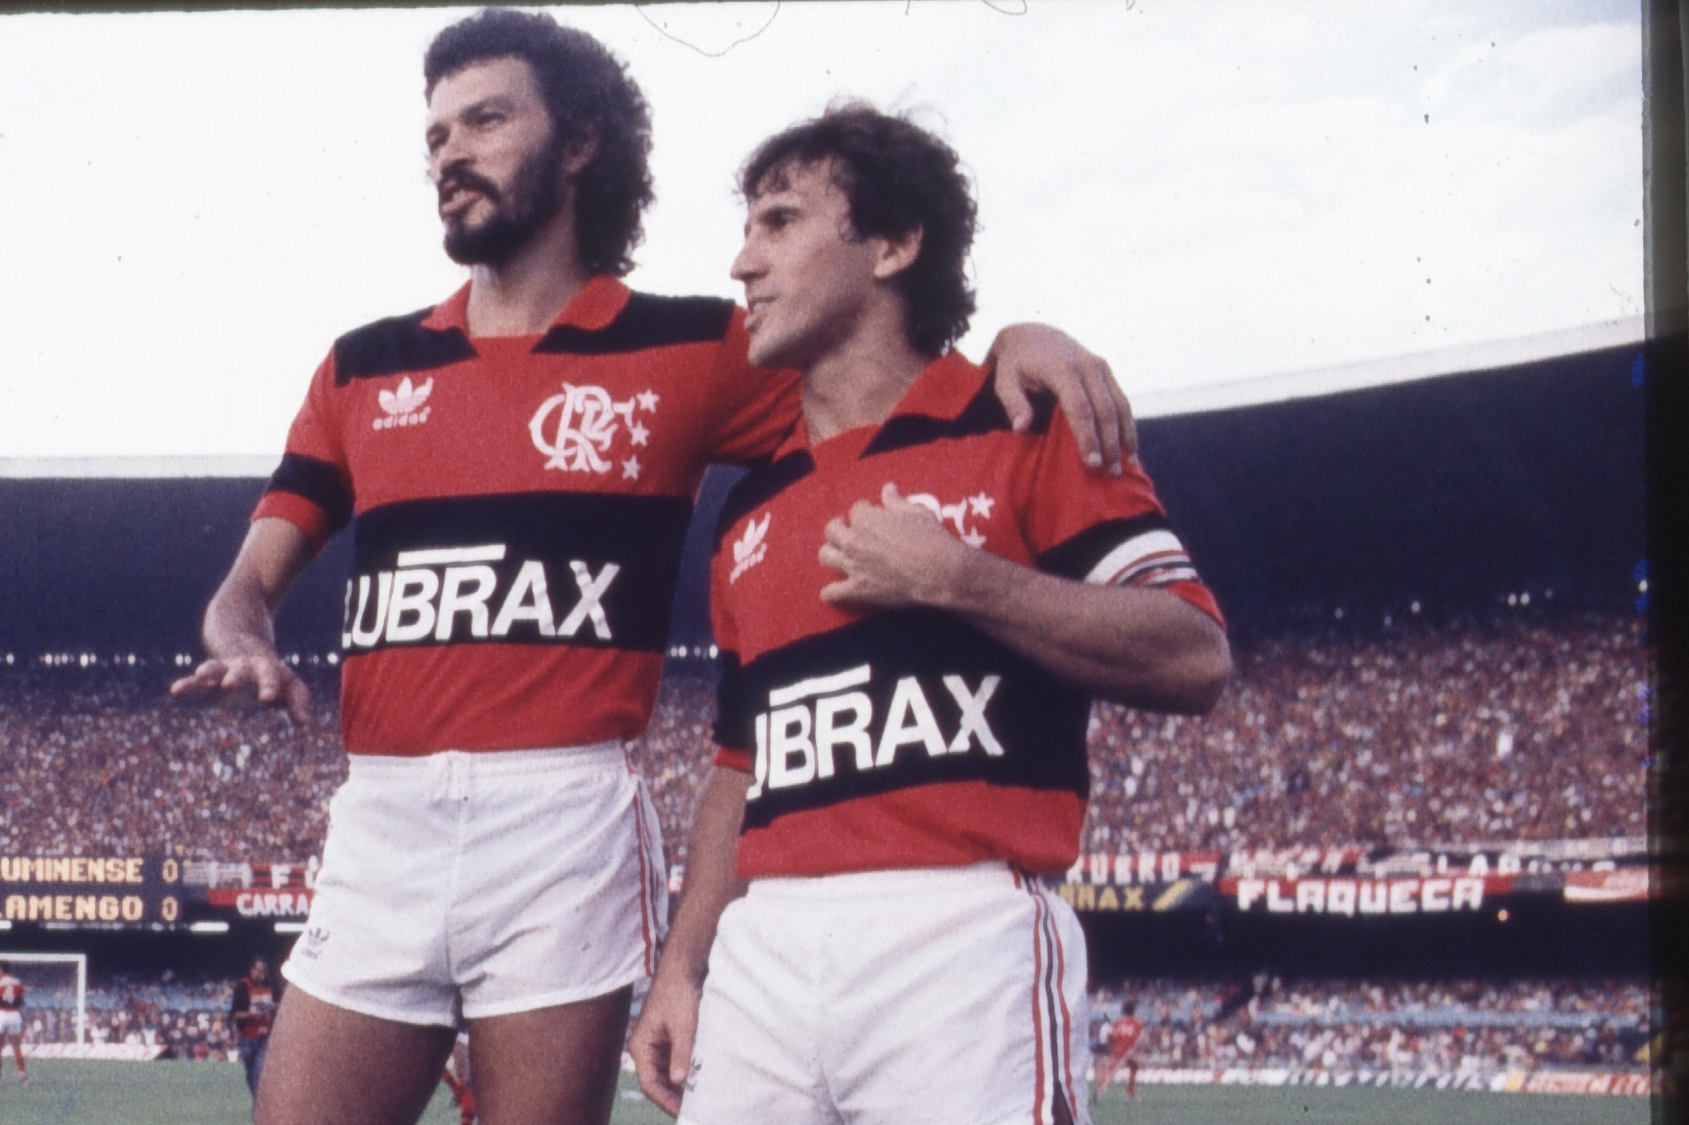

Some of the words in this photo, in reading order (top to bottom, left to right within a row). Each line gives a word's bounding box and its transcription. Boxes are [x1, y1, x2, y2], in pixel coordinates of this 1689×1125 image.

[342, 546, 620, 650] LUBRAX
[746, 664, 1005, 800] UBRAX
[236, 892, 309, 916] CARRA
